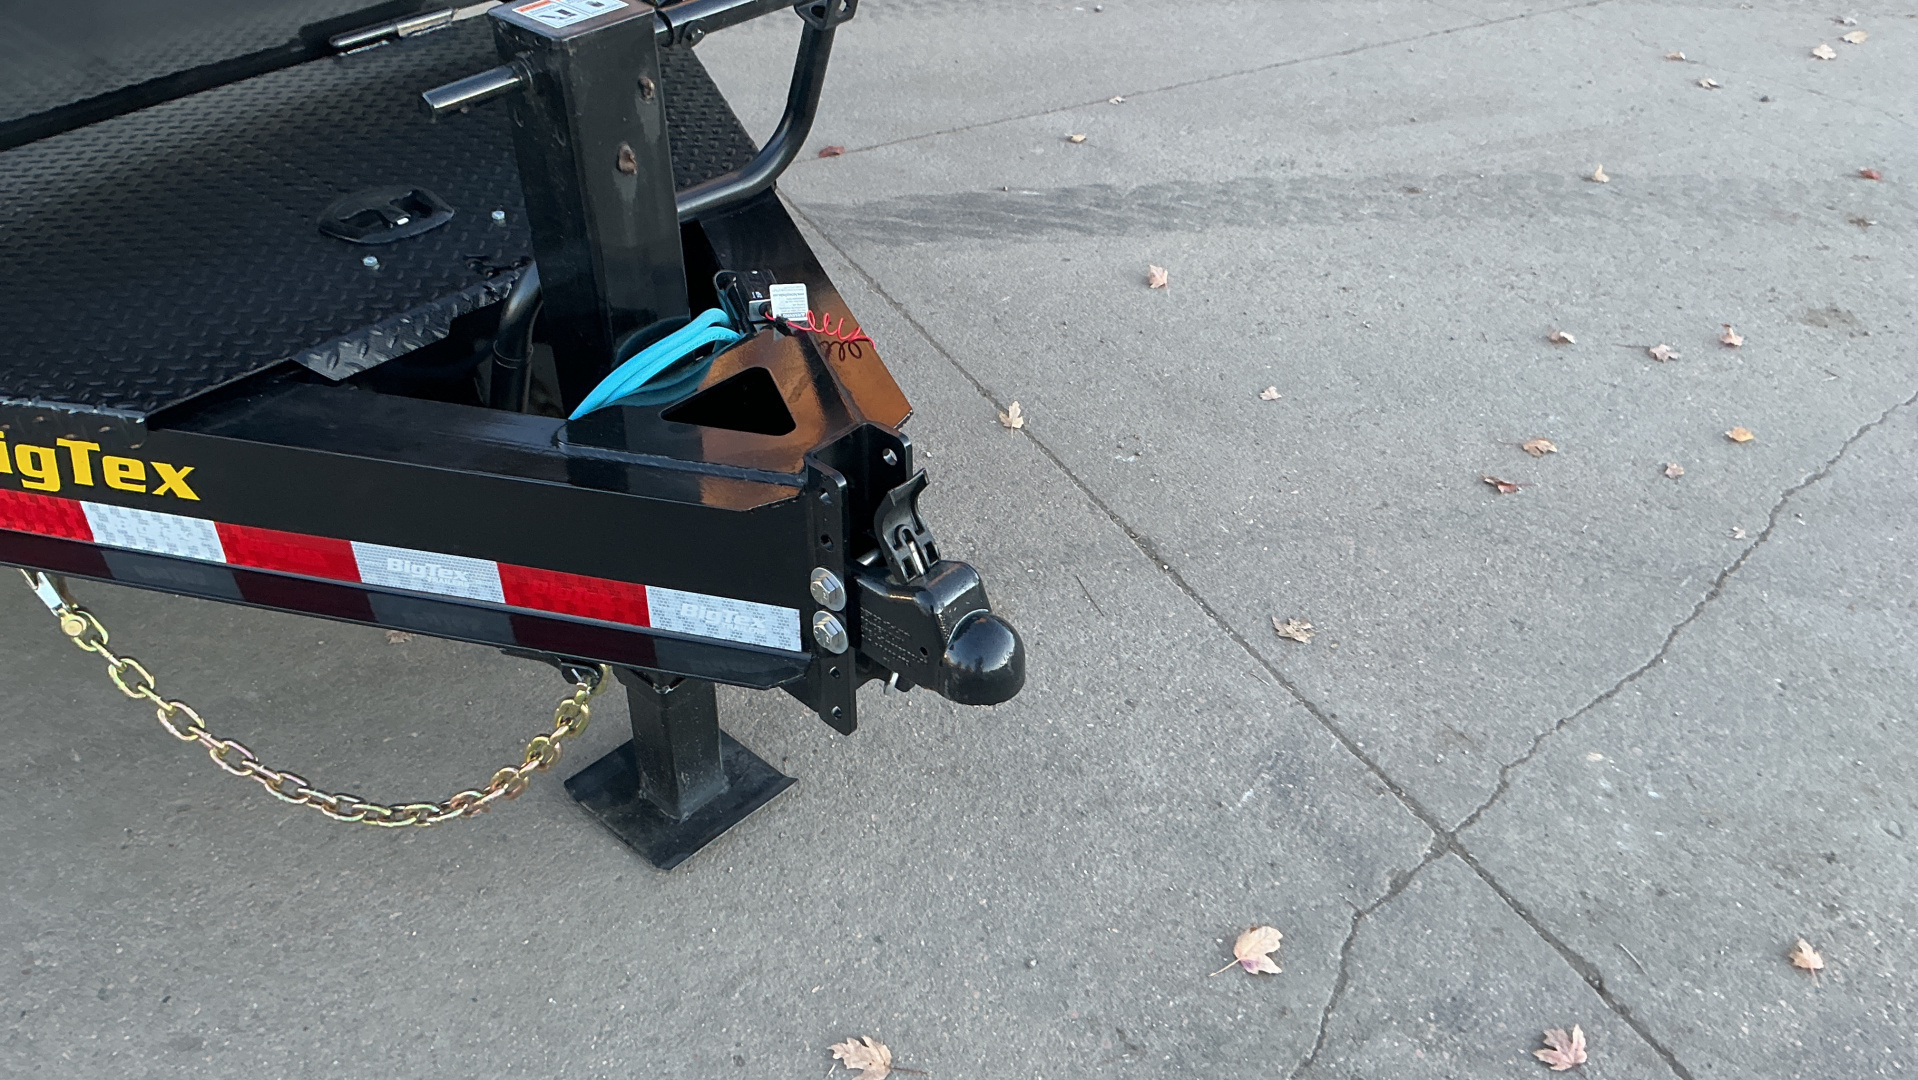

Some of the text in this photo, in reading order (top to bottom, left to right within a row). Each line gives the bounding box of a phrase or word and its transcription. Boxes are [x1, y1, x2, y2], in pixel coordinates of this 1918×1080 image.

[0, 431, 201, 501] igTex
[387, 557, 468, 581] BigTex
[680, 603, 766, 629] BigTex
